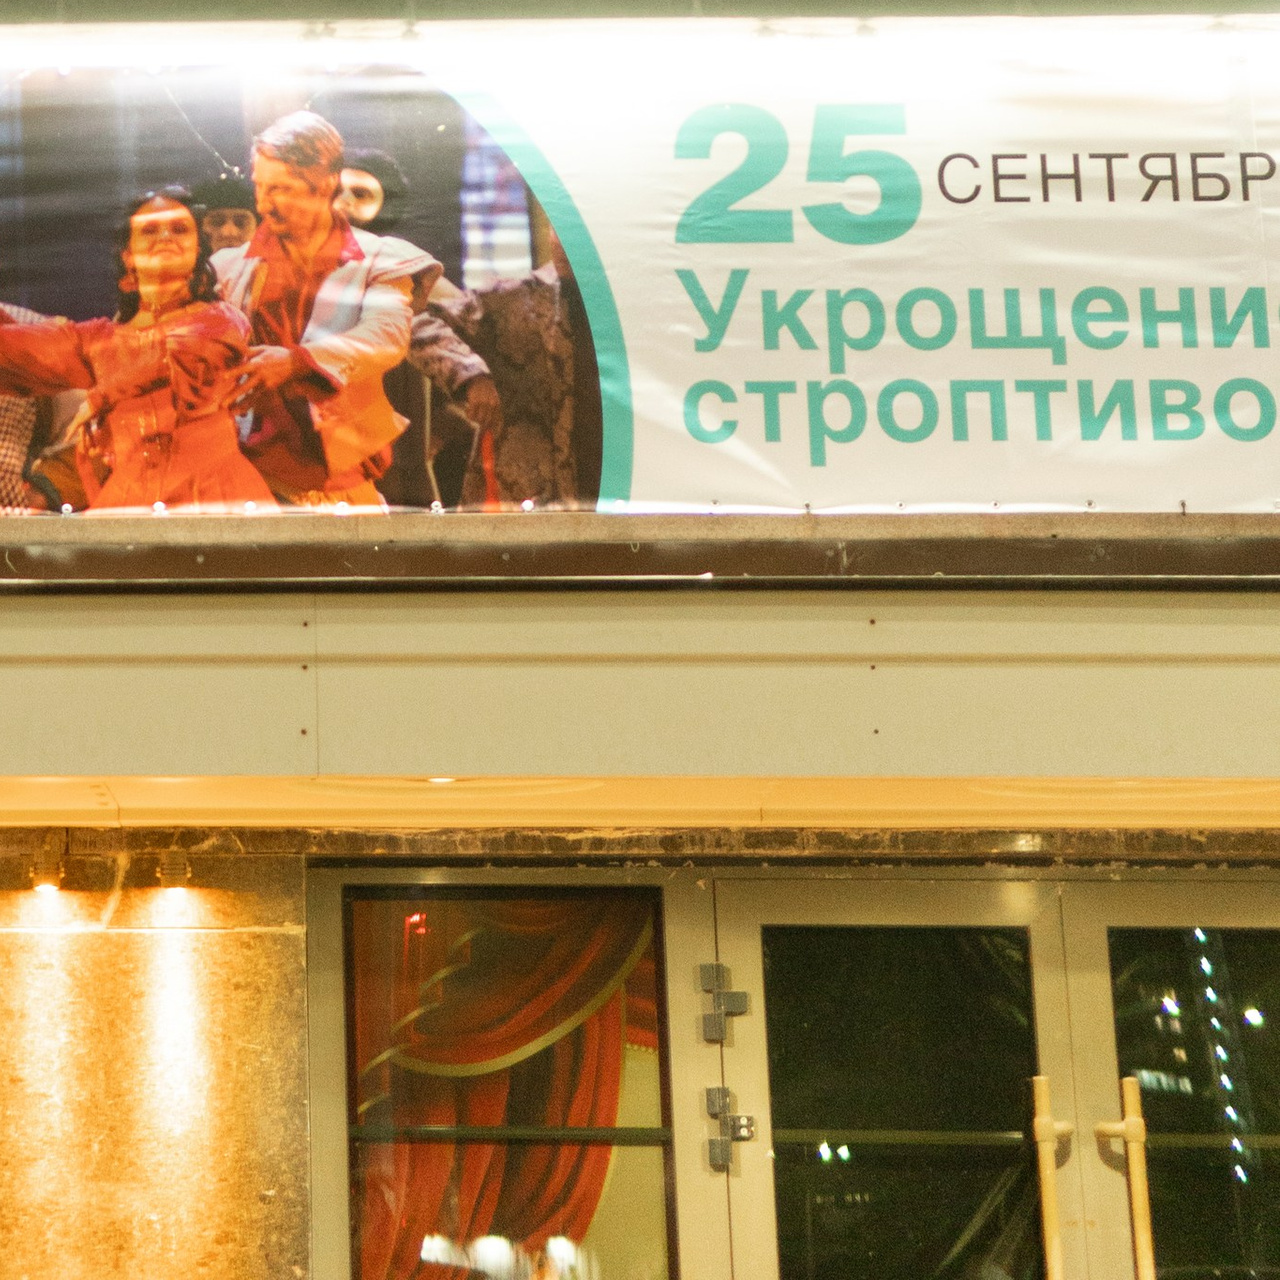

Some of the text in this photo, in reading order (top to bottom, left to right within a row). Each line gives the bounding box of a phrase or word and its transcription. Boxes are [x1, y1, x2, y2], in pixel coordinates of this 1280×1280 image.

[673, 101, 1278, 246] 25 СЕНТЯБР
[673, 268, 1280, 375] Укрощени
[682, 376, 1278, 468] строптиво
